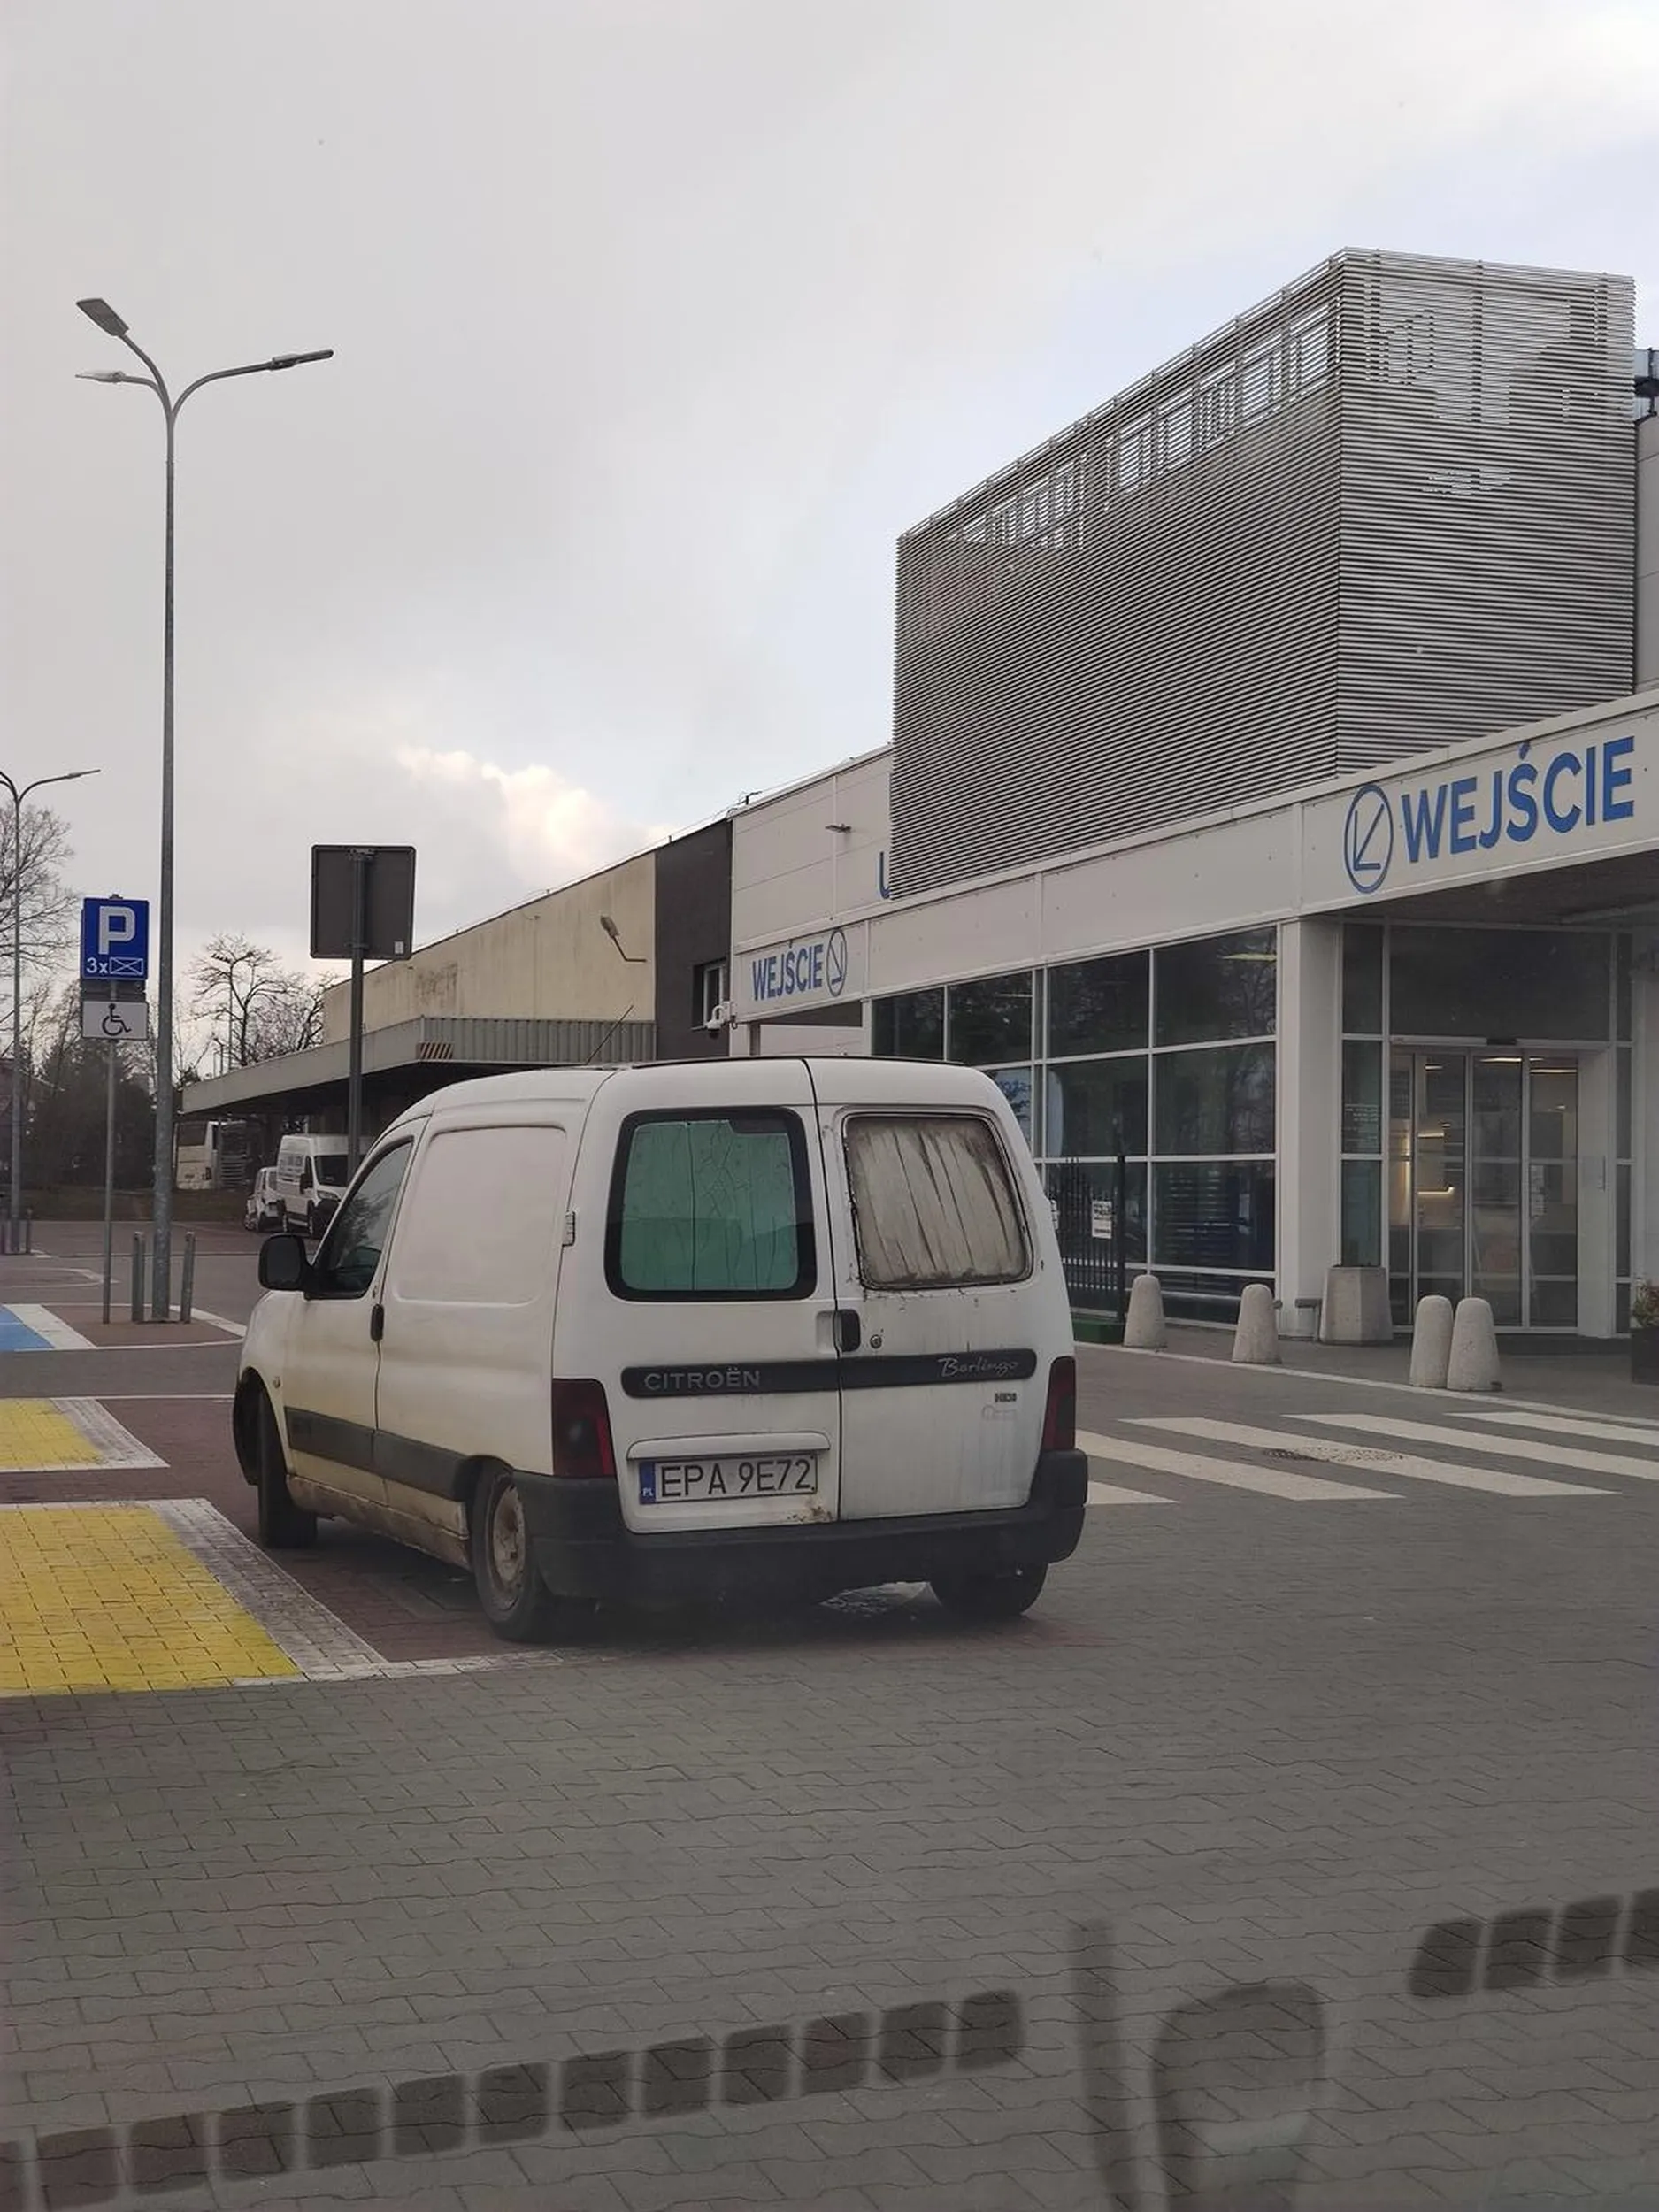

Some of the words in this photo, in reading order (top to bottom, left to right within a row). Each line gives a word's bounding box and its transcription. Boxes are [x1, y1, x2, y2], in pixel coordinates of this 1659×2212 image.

[1401, 735, 1635, 863] WEJŚCIE
[98, 905, 135, 955] P
[752, 940, 824, 1002] WEJŚCIE
[644, 1367, 760, 1391] CITROËN
[938, 1357, 1019, 1378] Berlingo
[661, 1463, 726, 1497] EPA
[738, 1459, 810, 1493] 9E72
